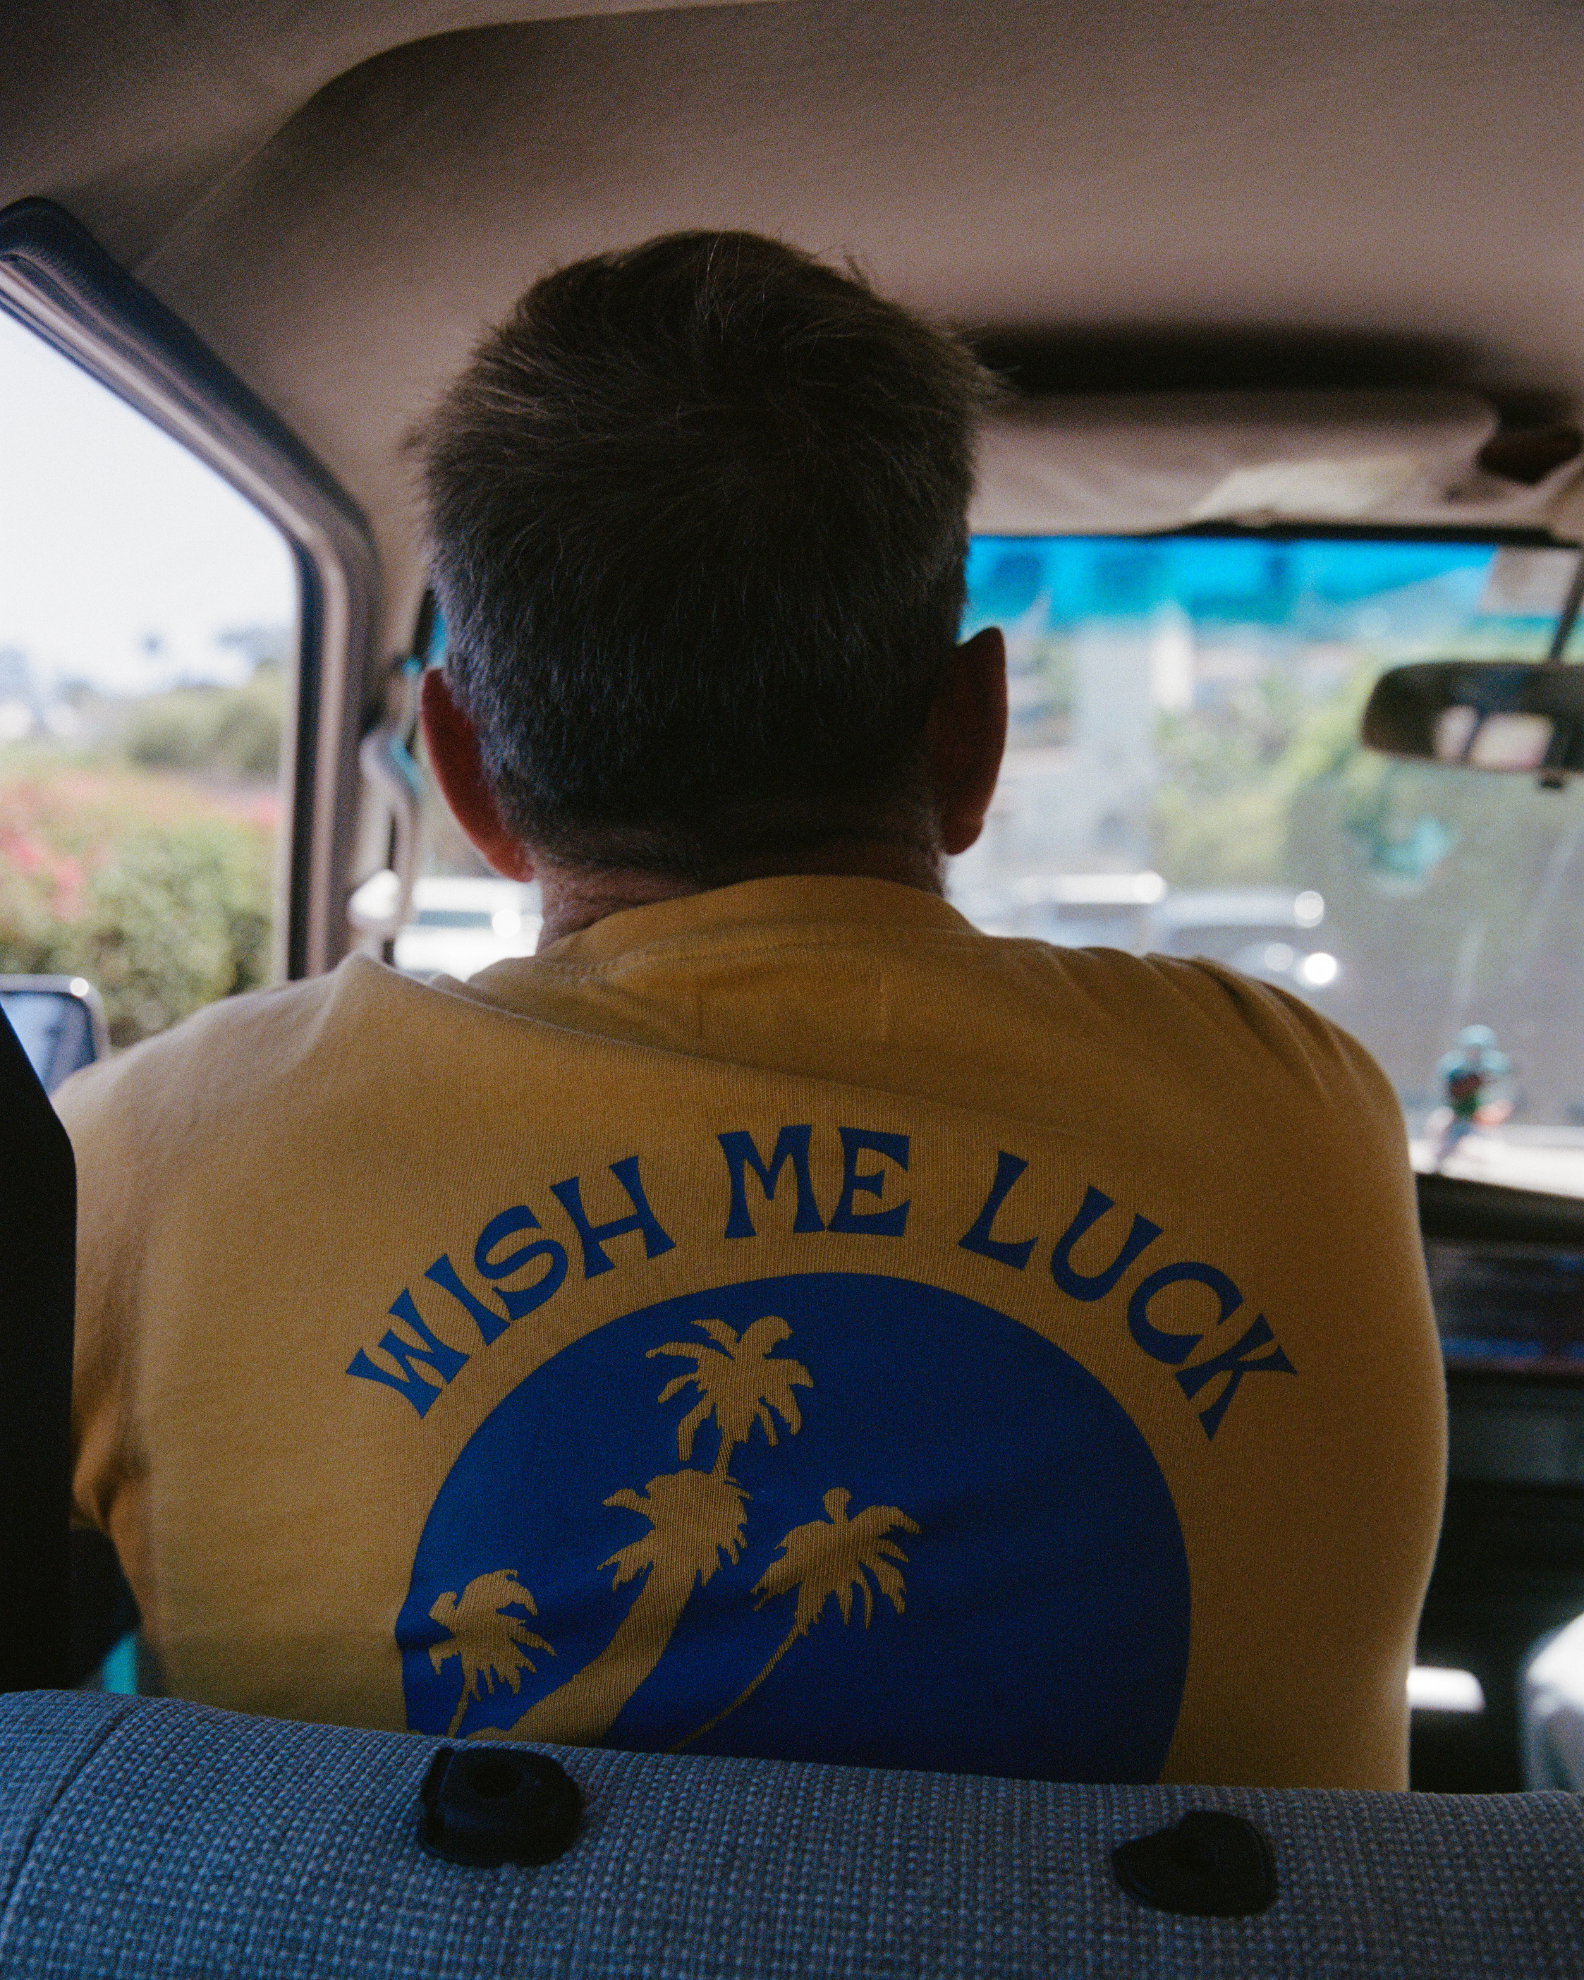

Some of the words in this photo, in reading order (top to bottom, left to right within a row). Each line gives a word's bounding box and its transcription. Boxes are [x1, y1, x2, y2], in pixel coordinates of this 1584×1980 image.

[346, 1155, 676, 1419] WISH
[717, 1124, 911, 1239] ME
[957, 1149, 1298, 1440] LUCK
